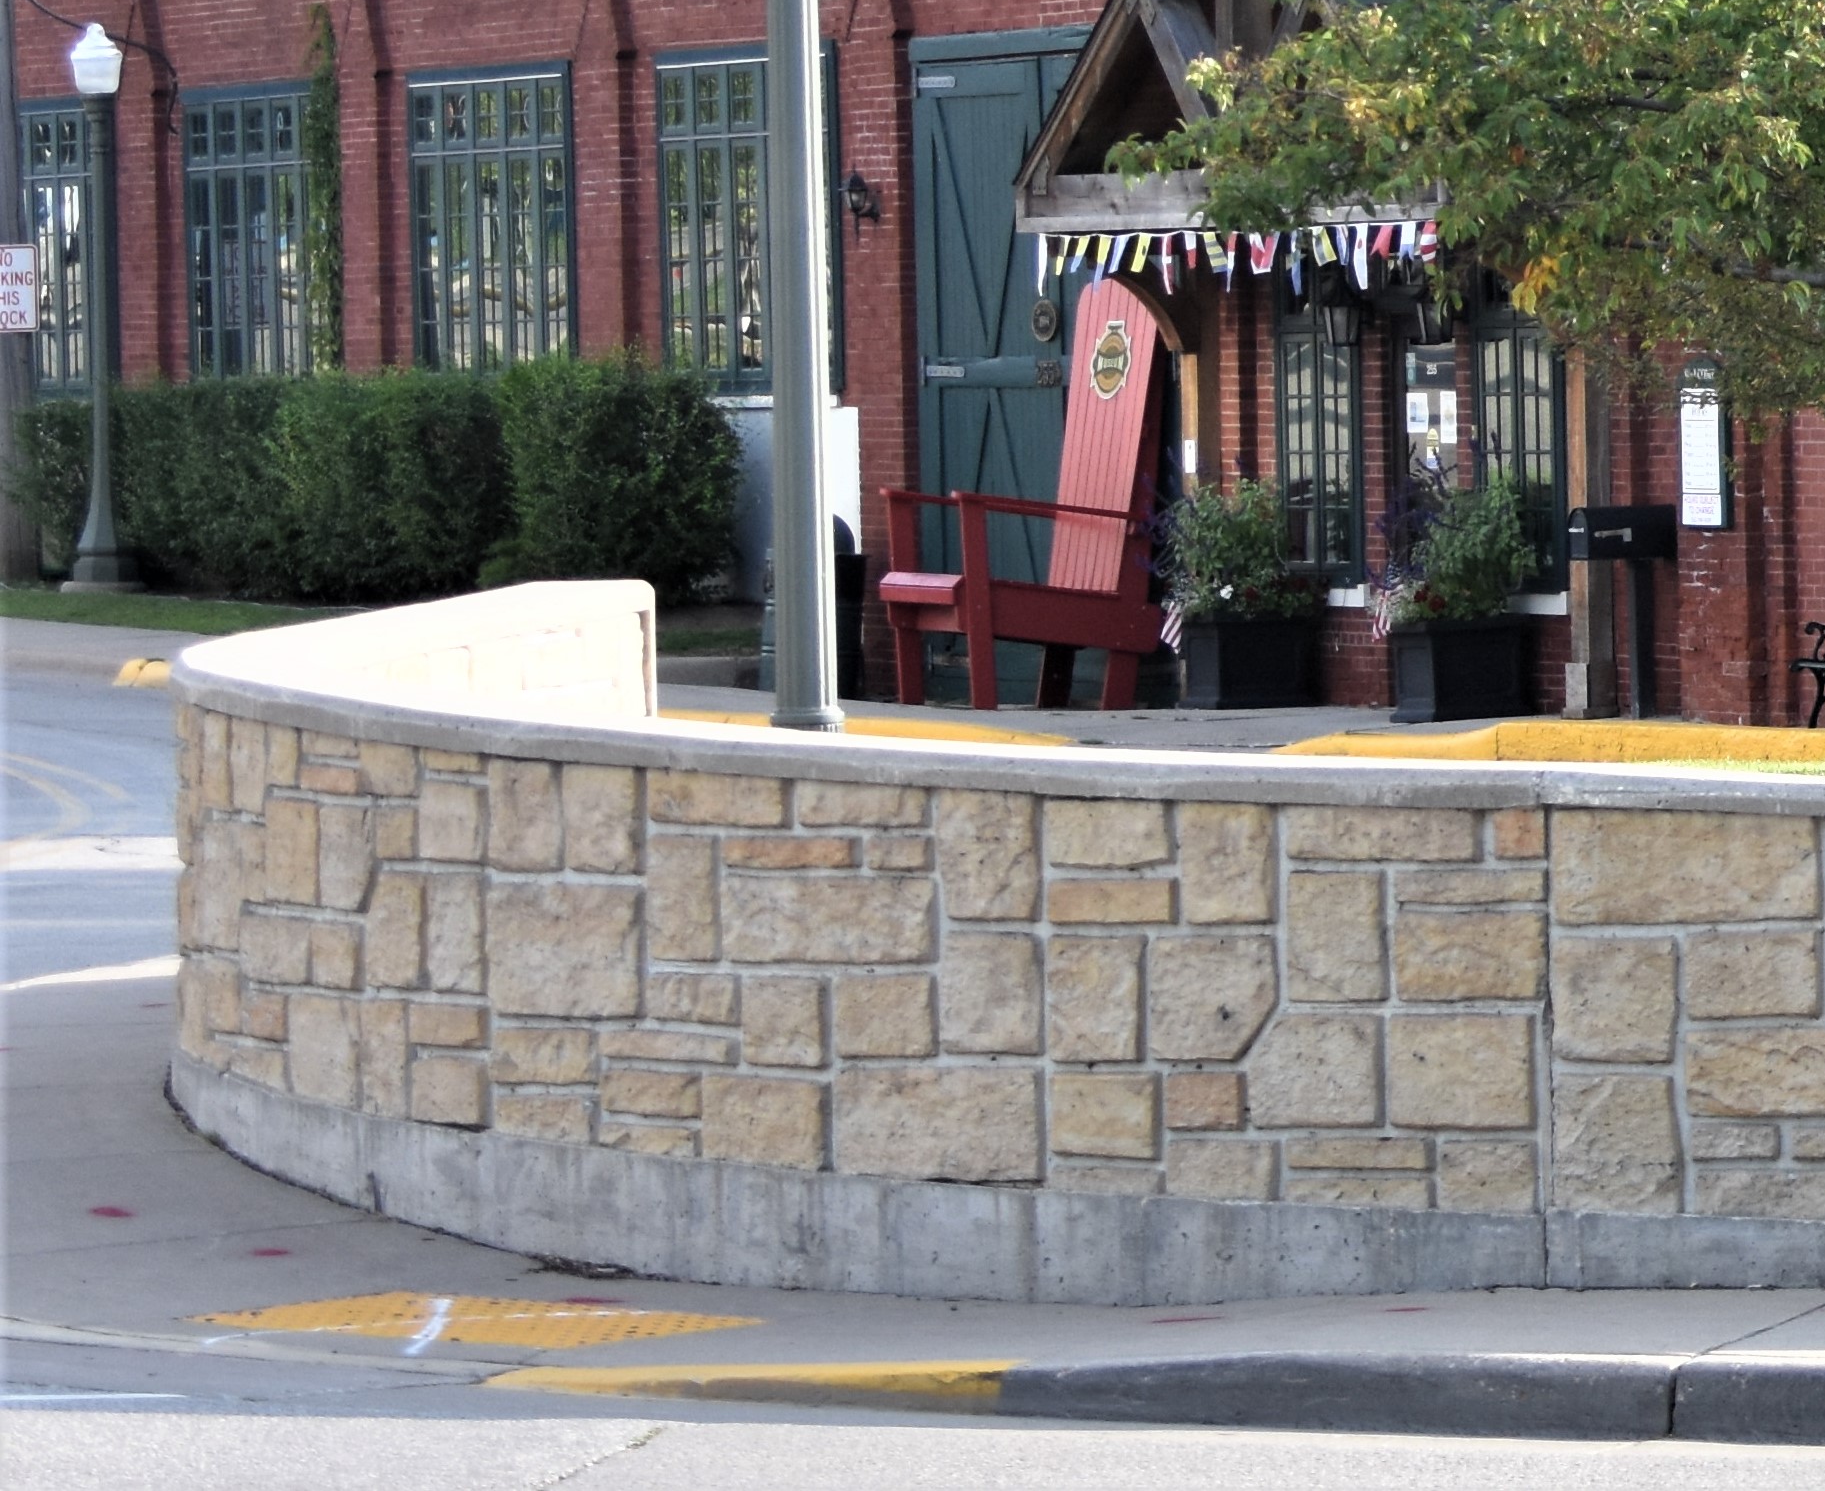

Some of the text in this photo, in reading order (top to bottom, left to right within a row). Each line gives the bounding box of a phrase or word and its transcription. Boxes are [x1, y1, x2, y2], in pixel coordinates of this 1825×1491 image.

[0, 271, 34, 286] KING
[0, 291, 20, 306] HIS
[0, 310, 28, 325] OCK
[1426, 364, 1438, 375] 255
